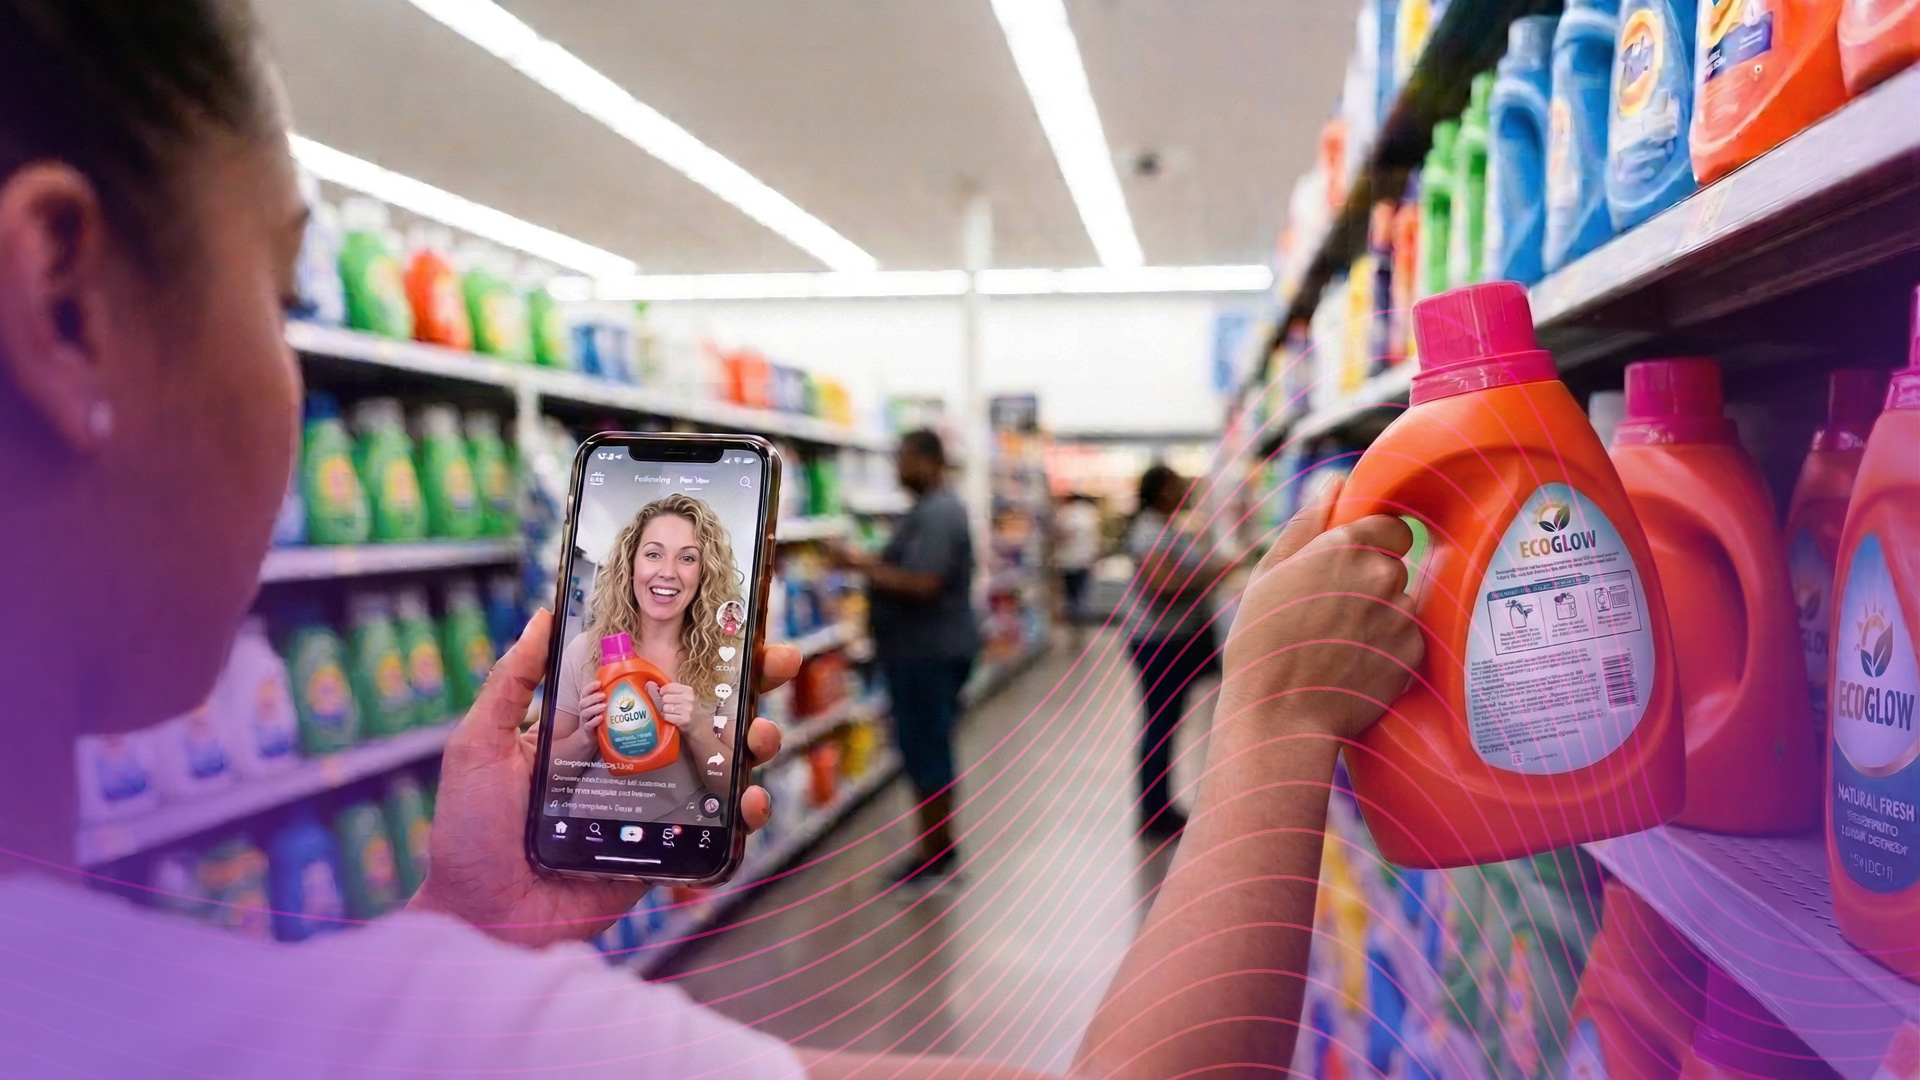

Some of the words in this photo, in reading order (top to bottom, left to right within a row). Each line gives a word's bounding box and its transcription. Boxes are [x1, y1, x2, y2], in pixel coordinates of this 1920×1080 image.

[1519, 529, 1596, 559] ECOGLOW
[610, 710, 647, 725] ECOGLOW
[1838, 680, 1915, 731] ECOGLOW
[1838, 782, 1878, 813] NATURAL
[1879, 796, 1915, 822] FRESH
